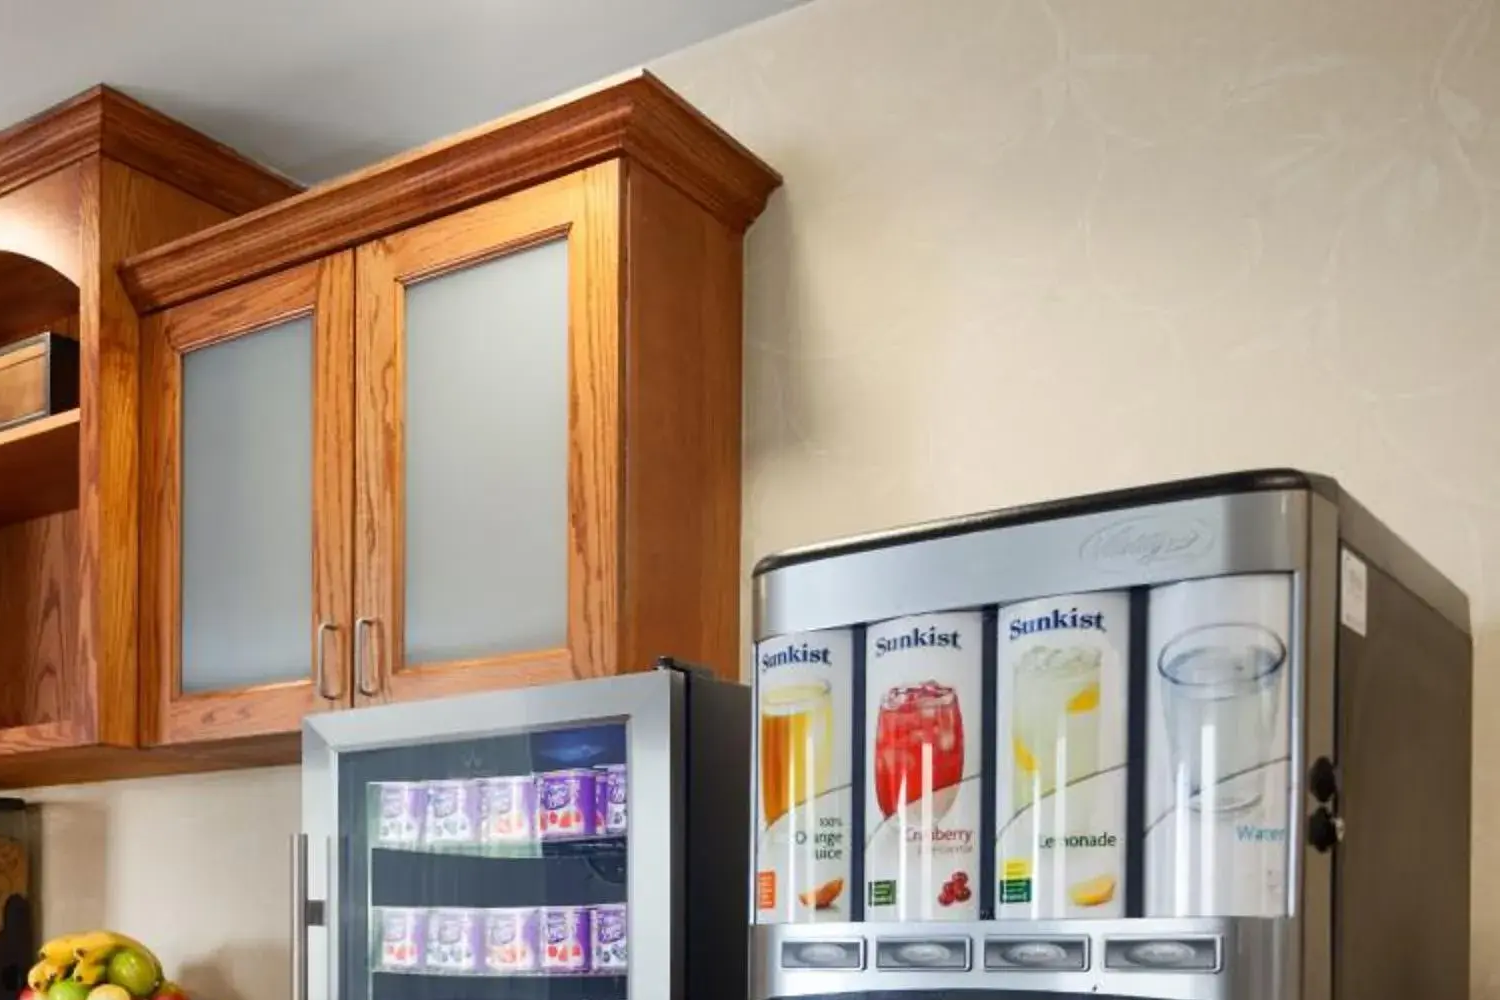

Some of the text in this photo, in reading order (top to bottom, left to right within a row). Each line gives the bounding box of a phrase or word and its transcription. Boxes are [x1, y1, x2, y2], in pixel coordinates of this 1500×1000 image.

[1010, 607, 1107, 640] Sunkist
[761, 642, 832, 673] Sunkist
[875, 625, 962, 658] Sunkist
[1236, 824, 1285, 841] Water
